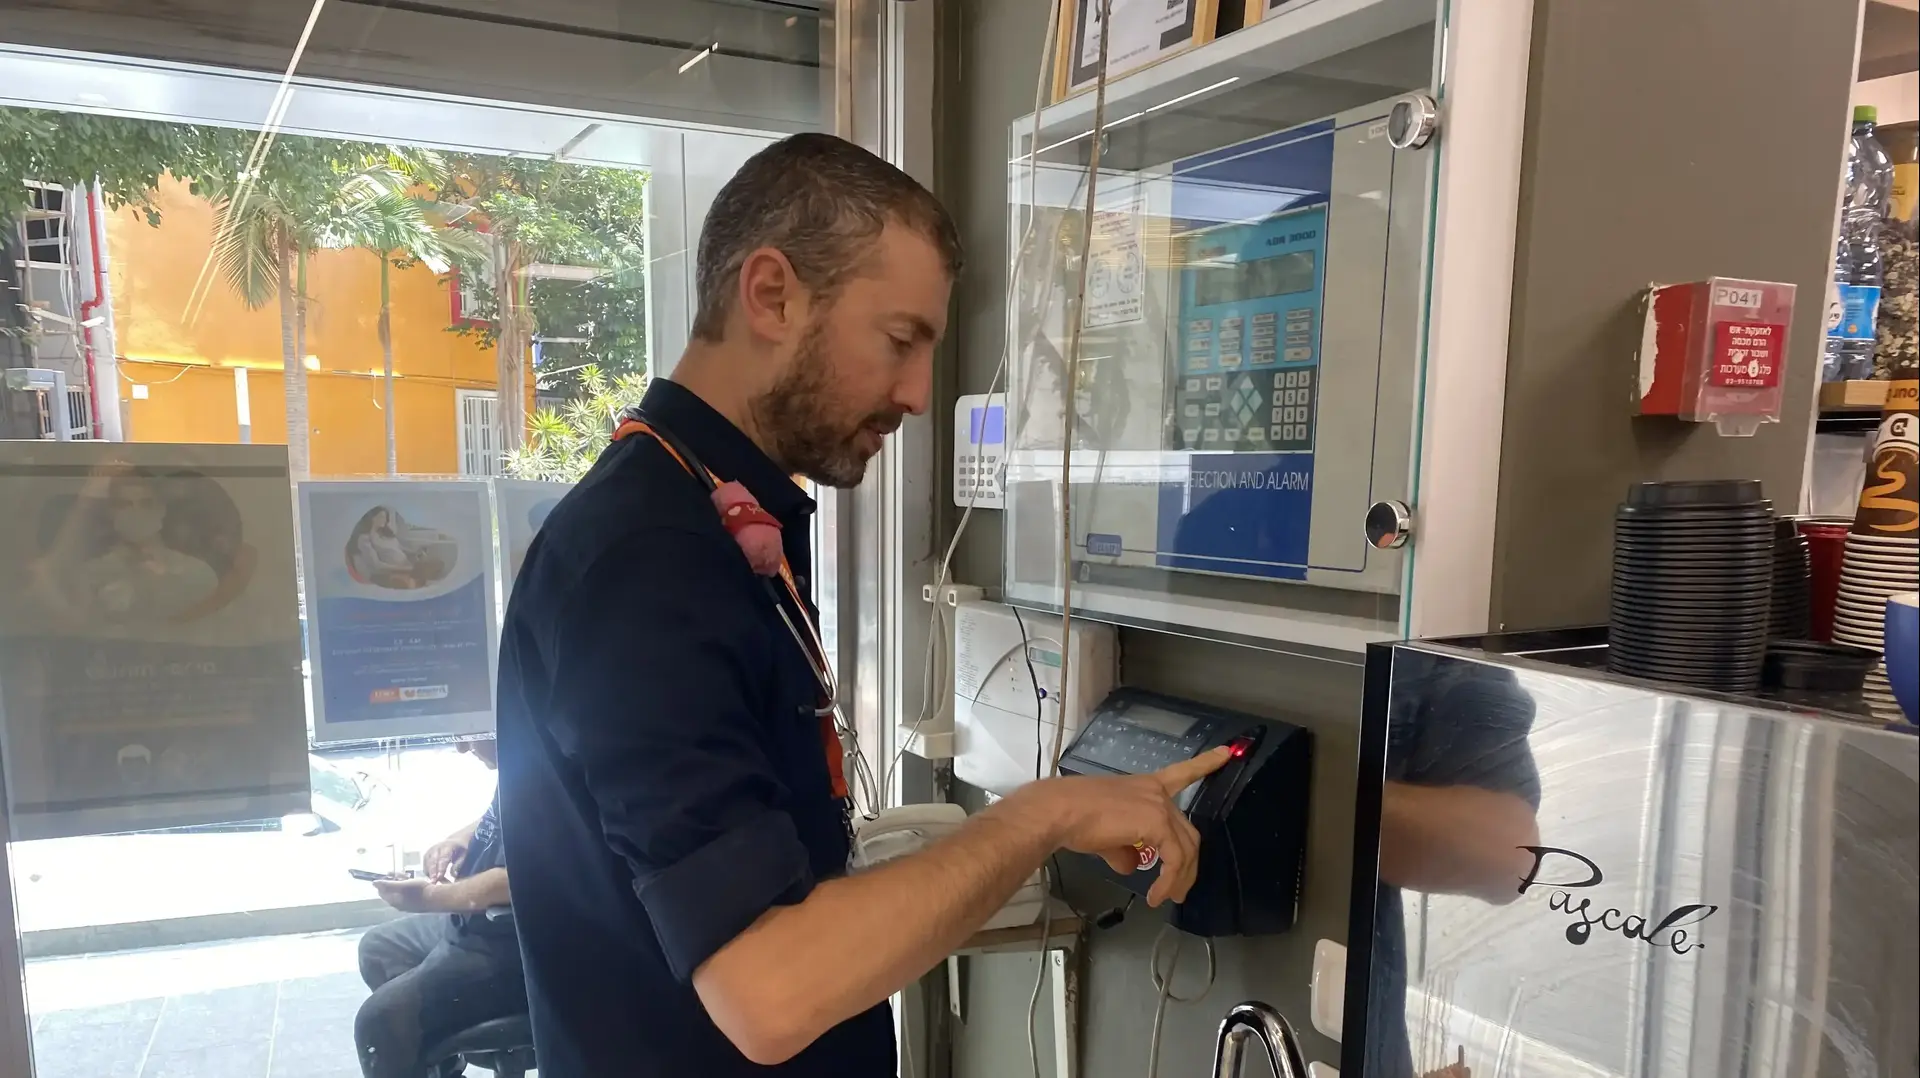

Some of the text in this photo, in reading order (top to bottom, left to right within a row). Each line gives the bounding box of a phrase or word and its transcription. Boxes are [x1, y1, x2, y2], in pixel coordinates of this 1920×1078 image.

[1717, 289, 1759, 305] P041
[1185, 470, 1237, 489] ETECTION
[1239, 471, 1265, 490] AND
[1266, 471, 1309, 491] ALARM
[1515, 845, 1719, 955] Pascale
